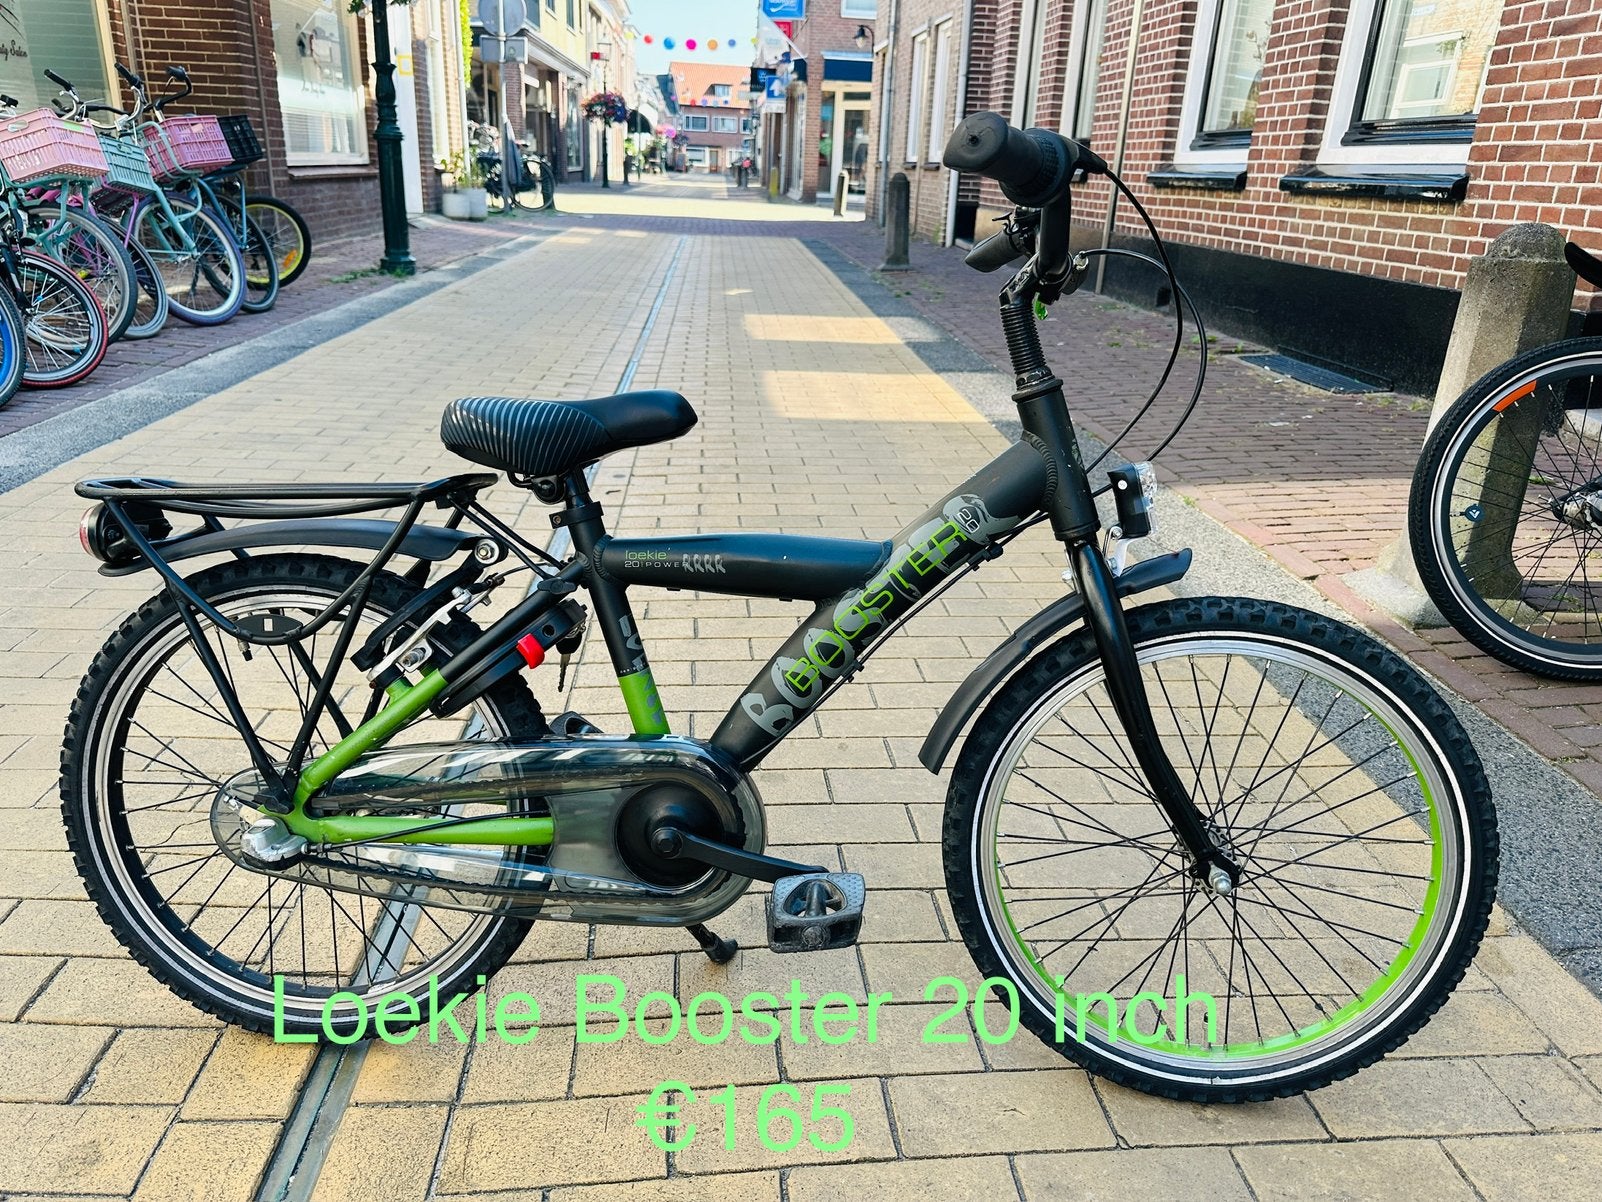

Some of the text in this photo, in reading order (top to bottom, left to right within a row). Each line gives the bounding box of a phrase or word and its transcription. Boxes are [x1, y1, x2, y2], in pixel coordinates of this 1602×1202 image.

[957, 508, 980, 533] 20
[624, 549, 667, 560] loekie
[624, 560, 640, 568] 20
[783, 519, 968, 692] BOOSTER
